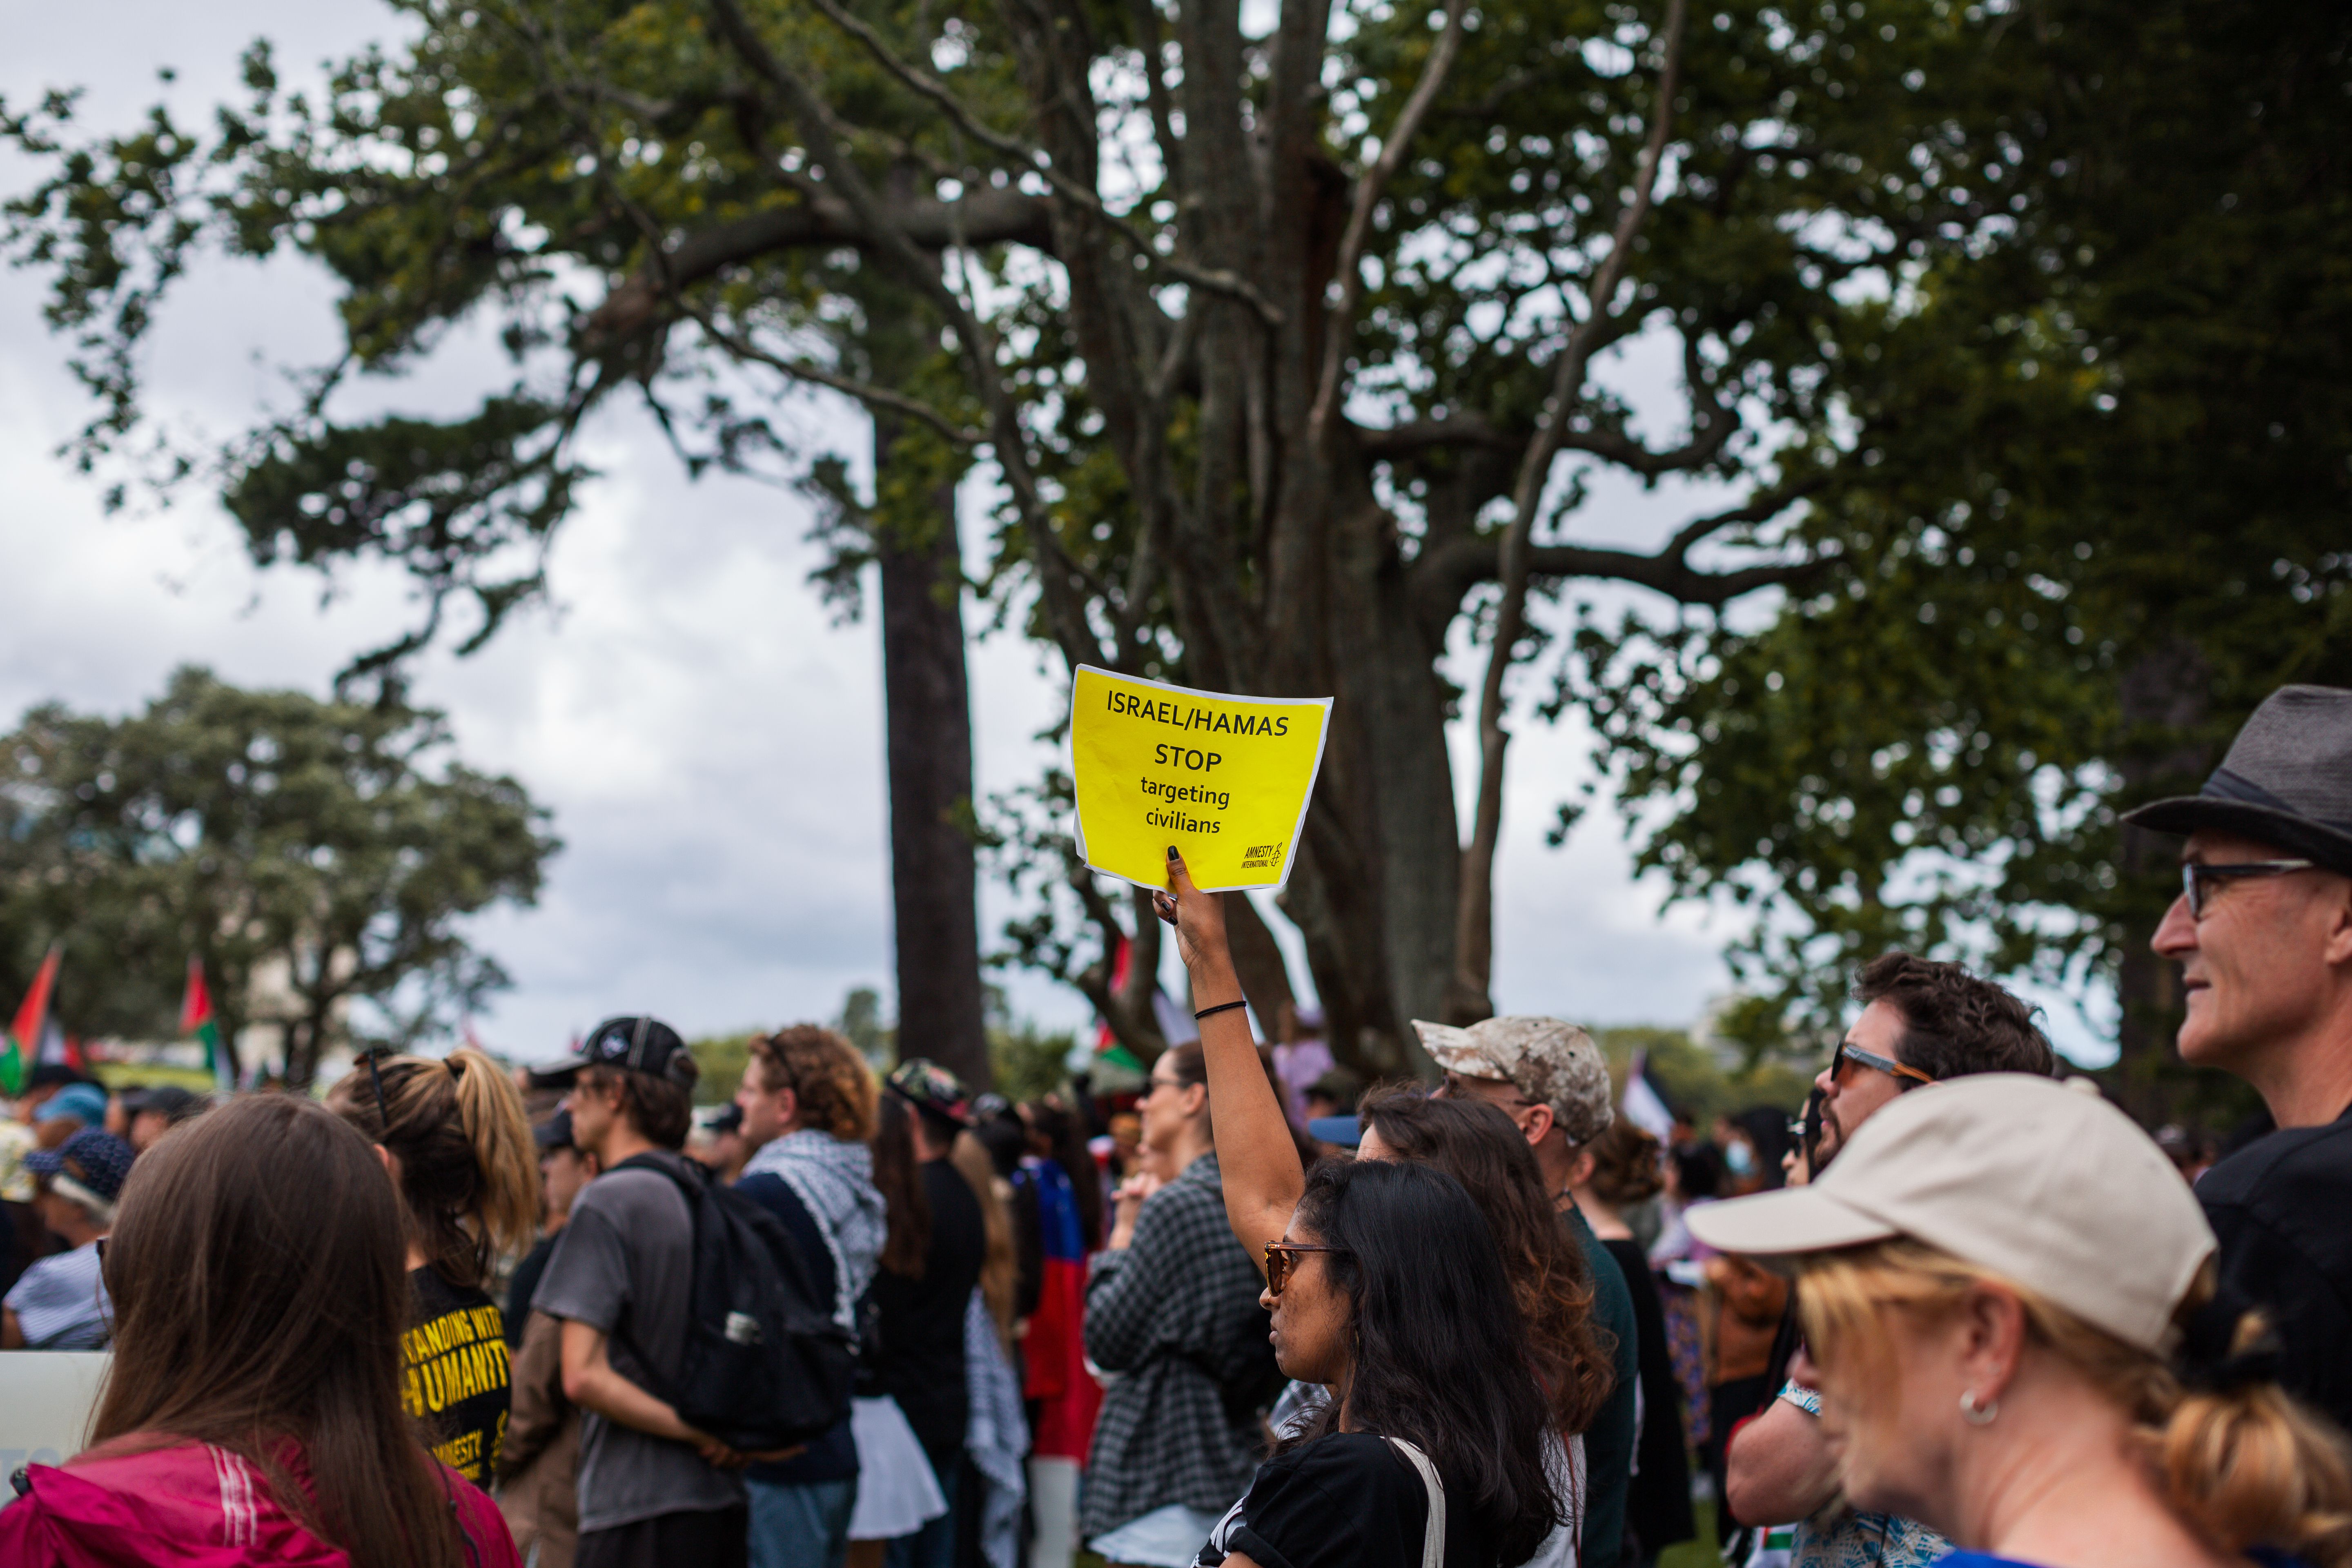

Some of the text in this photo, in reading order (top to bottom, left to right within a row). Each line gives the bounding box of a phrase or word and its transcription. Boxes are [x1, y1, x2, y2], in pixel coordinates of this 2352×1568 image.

[1107, 690, 1289, 737] ISRAEL/HAMAS
[1154, 743, 1222, 773] STOP
[1140, 776, 1230, 811] targeting
[1146, 807, 1221, 834] civilians
[1241, 860, 1269, 869] INTERNATIONAL
[1244, 845, 1274, 859] AMNESTY
[400, 1308, 475, 1366] TANDING
